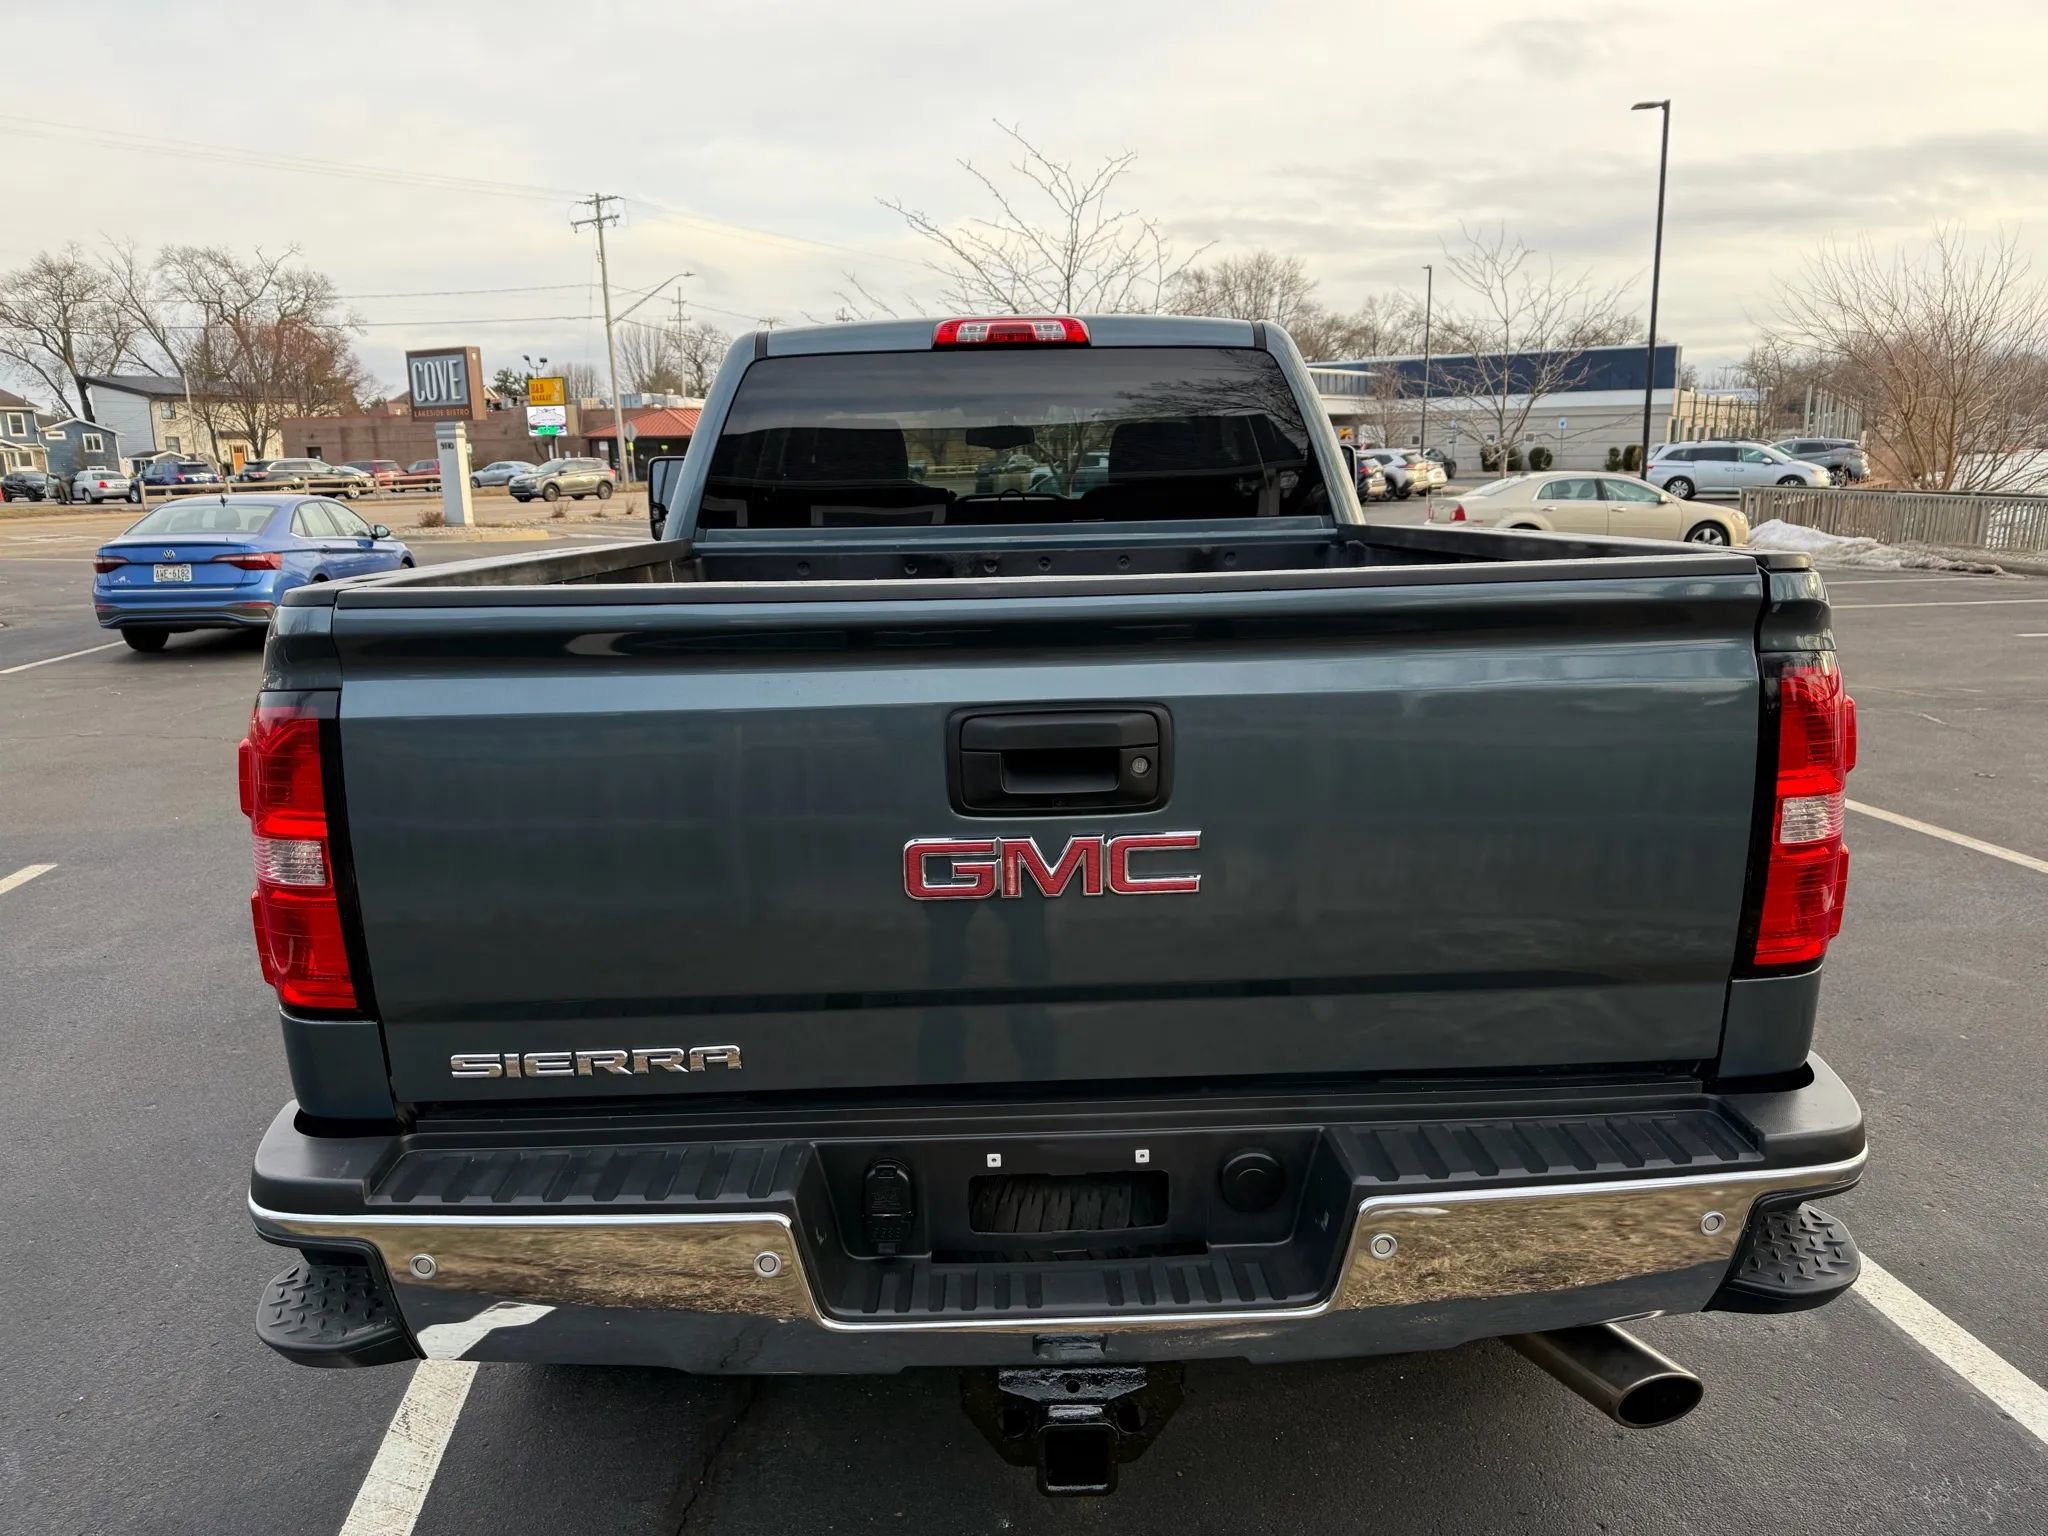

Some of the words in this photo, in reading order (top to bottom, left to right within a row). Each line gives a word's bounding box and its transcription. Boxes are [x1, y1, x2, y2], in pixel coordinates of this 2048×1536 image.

[410, 360, 462, 402] COVE
[414, 409, 445, 417] LAKESIDE
[446, 408, 470, 416] BISTRO
[902, 829, 1203, 903] GMC
[449, 1043, 743, 1080] SIERRA
